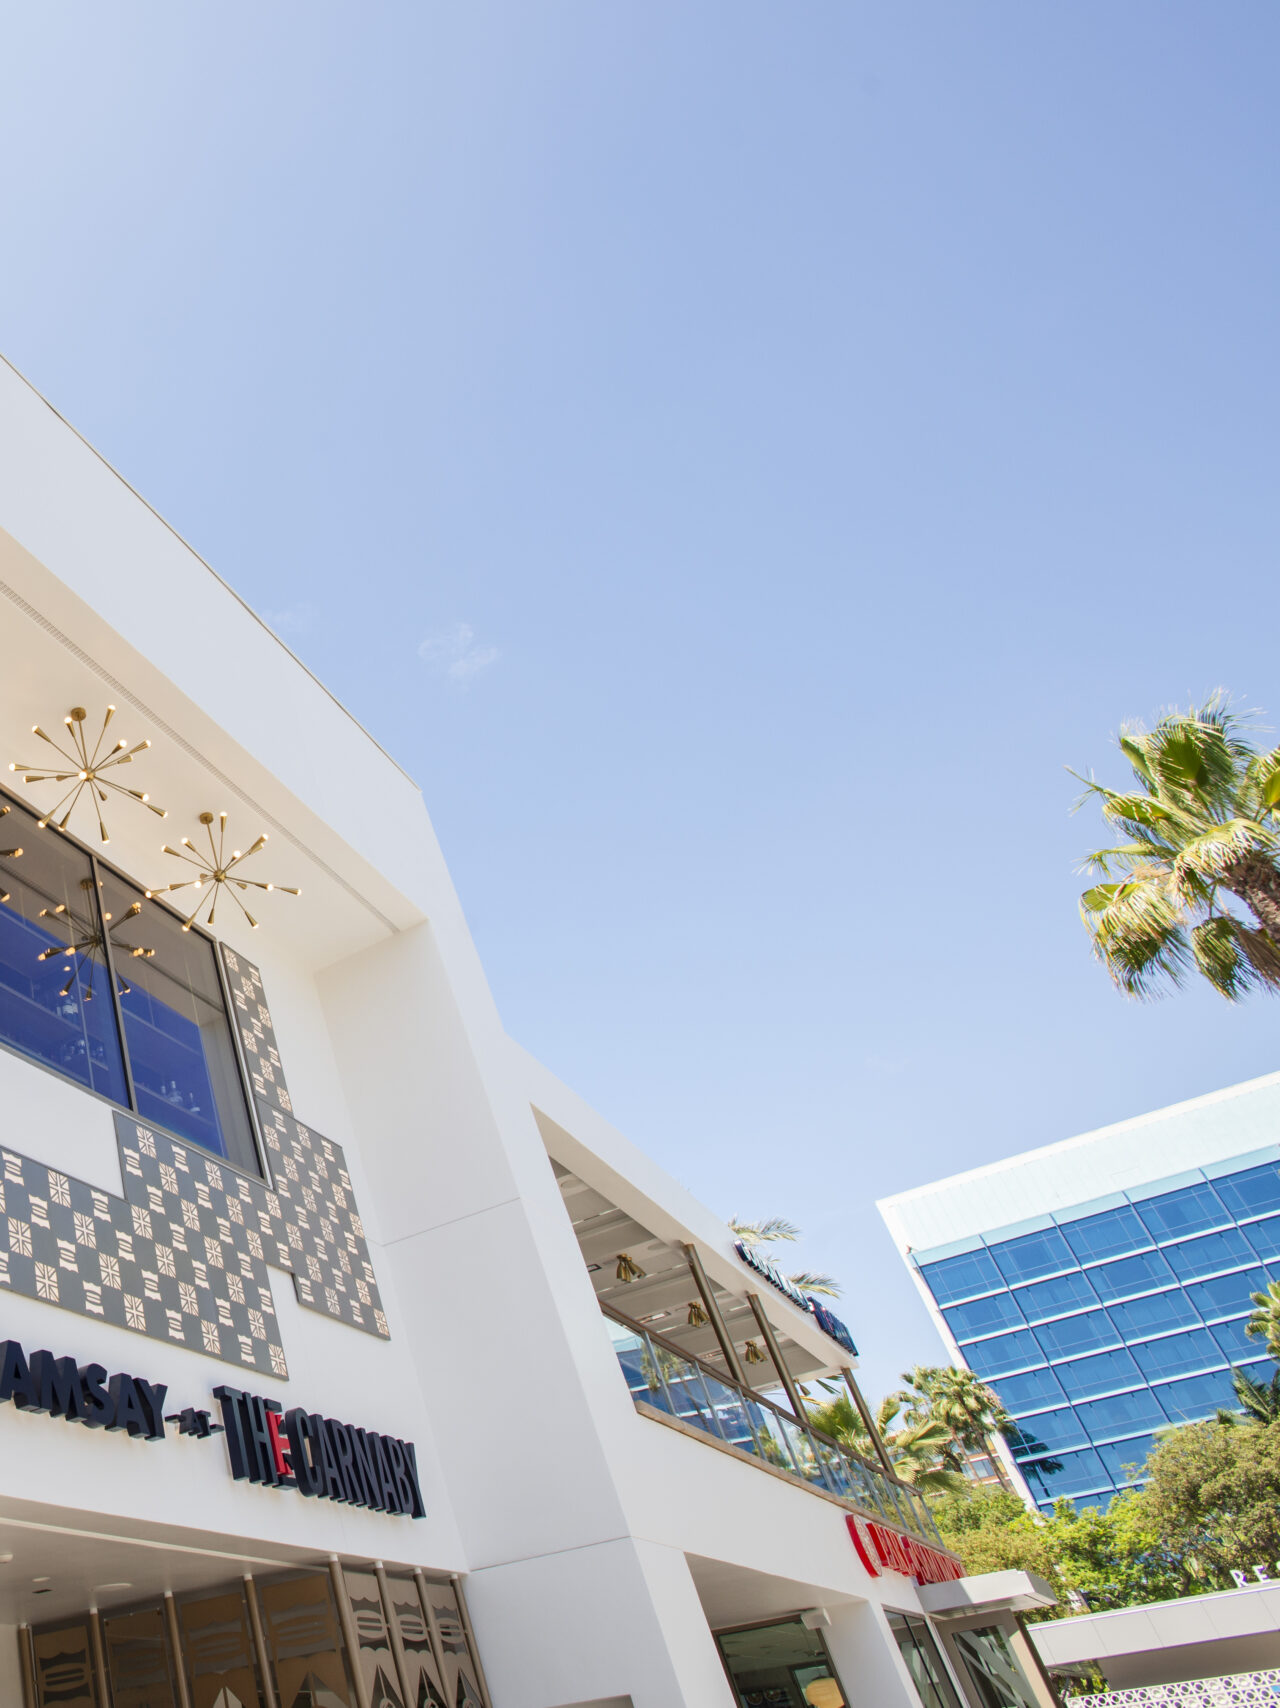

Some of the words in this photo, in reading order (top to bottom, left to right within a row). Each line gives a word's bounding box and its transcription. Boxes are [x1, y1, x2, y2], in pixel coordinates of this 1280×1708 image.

[212, 1385, 298, 1490] THE
[284, 1406, 427, 1520] CARNABY
[1229, 1560, 1280, 1588] RE
